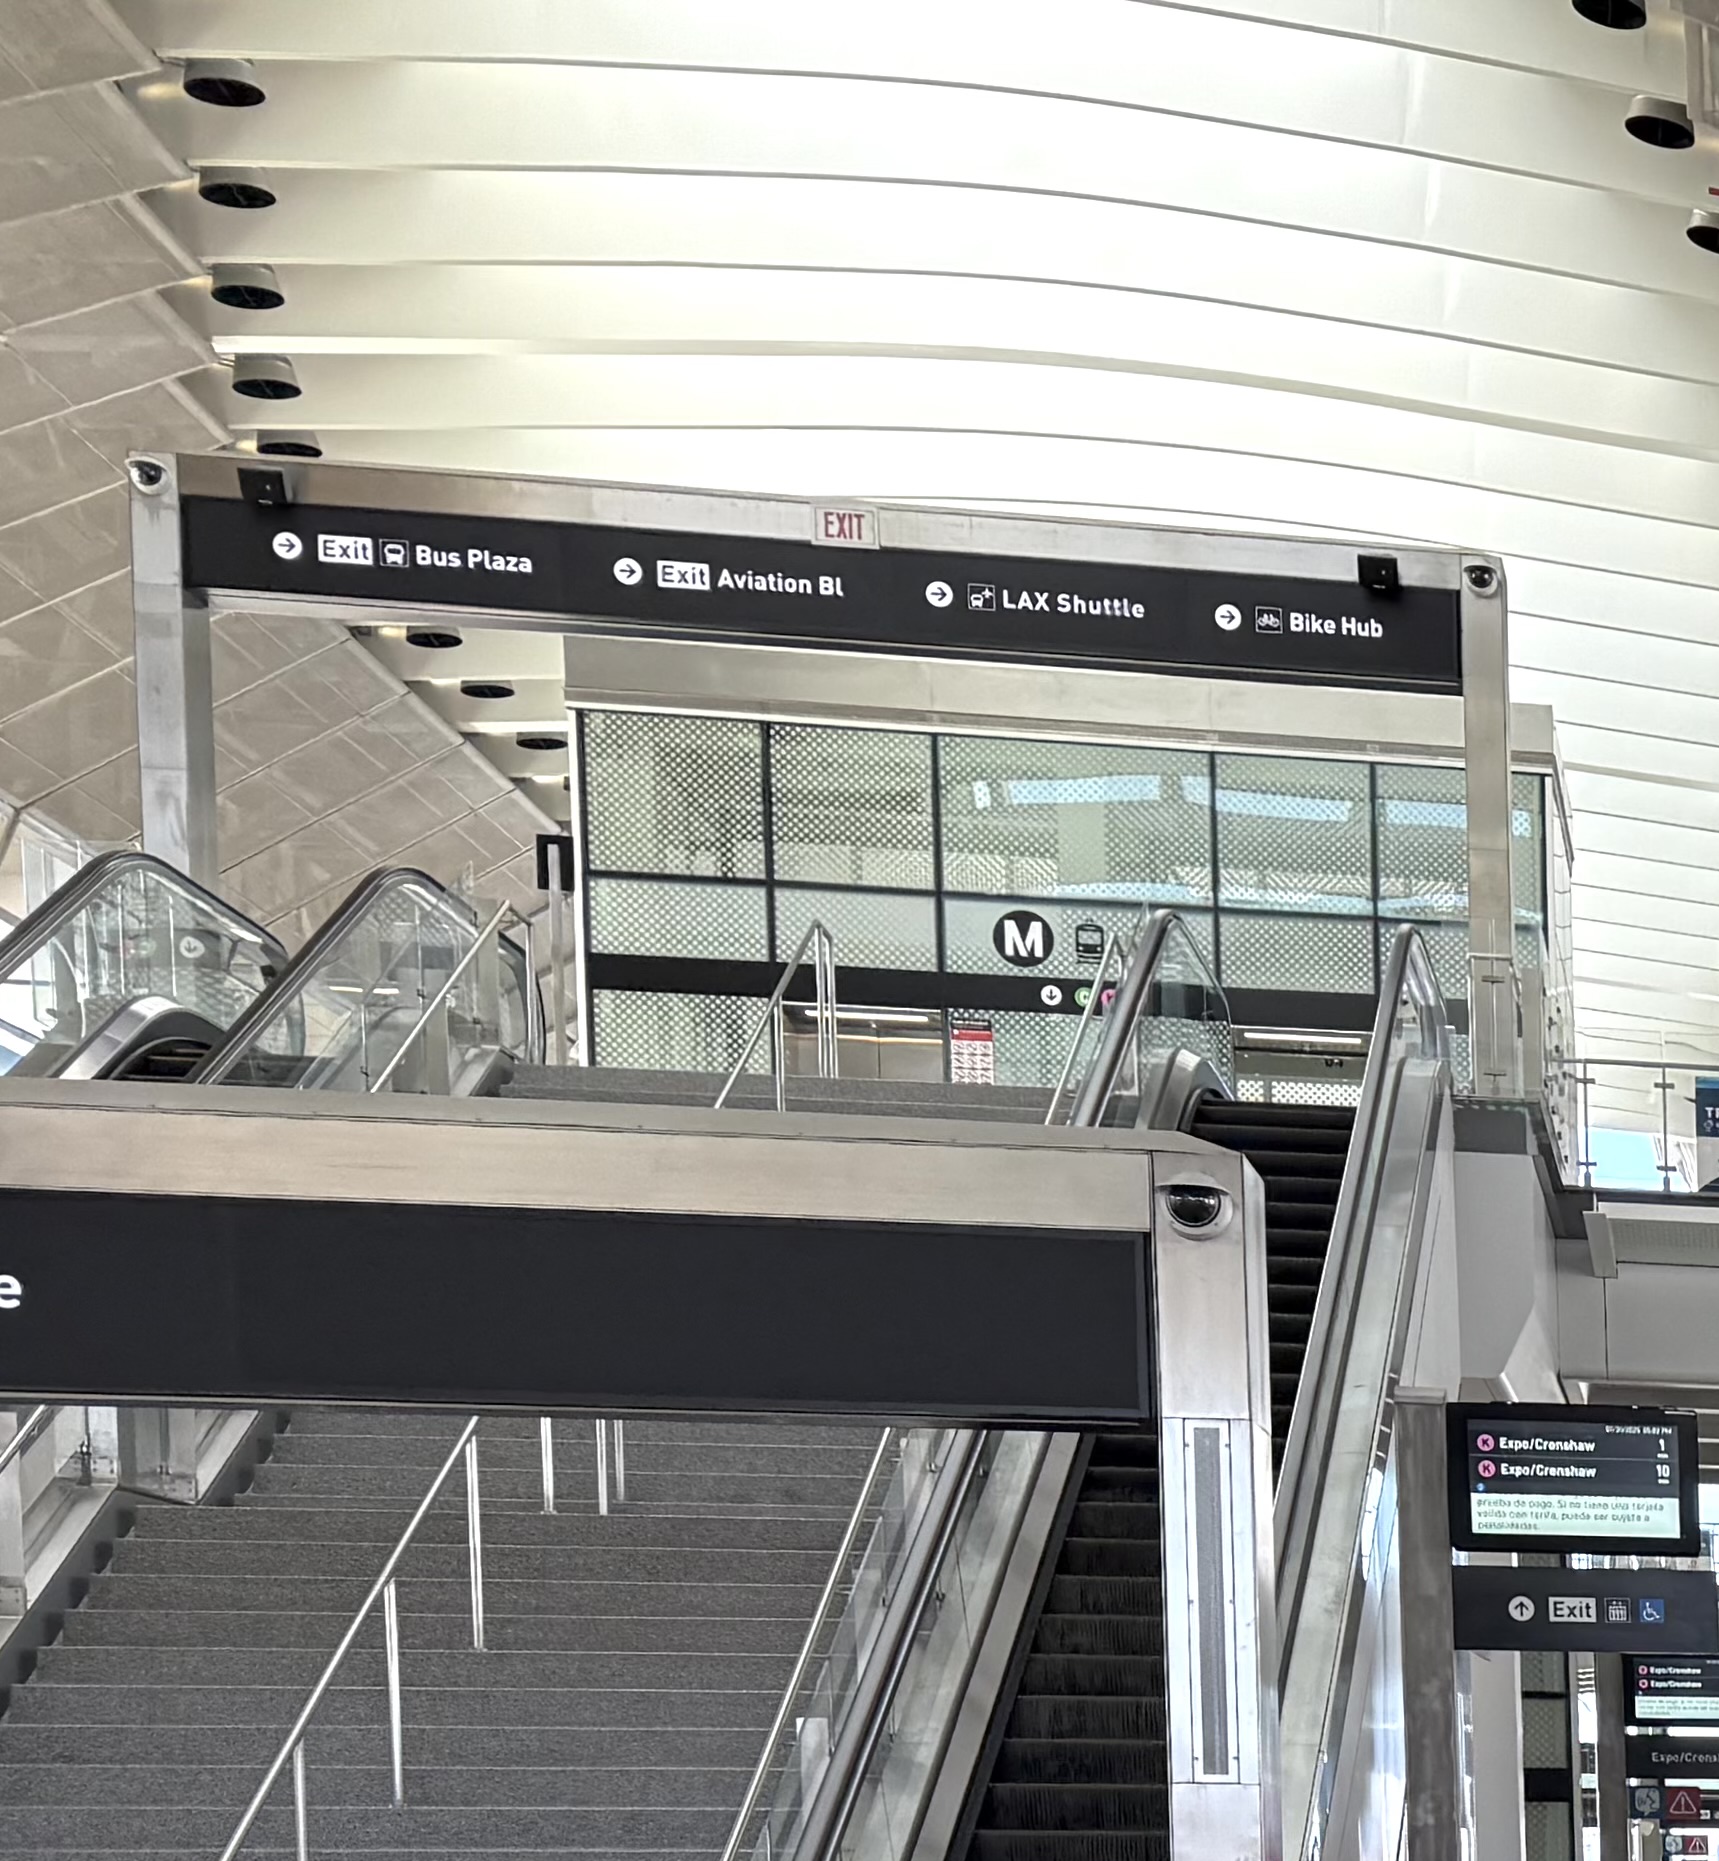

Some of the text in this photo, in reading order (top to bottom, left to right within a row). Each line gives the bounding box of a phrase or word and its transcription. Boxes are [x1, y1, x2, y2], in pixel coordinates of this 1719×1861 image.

[823, 511, 865, 541] EXIT
[322, 539, 533, 574] Exit Bus Plaza
[661, 564, 707, 586] Exit
[717, 568, 812, 595] Aviation
[1002, 589, 1145, 619] LAX Shuttle
[1289, 612, 1384, 639] Bike Hub
[1003, 919, 1044, 958] M
[1499, 1437, 1596, 1452] Expo/Crenshaw
[1658, 1438, 1665, 1451] 1
[1500, 1463, 1597, 1478] Expo/Crenshaw
[1656, 1464, 1670, 1478] 10
[1553, 1601, 1593, 1618] Exit
